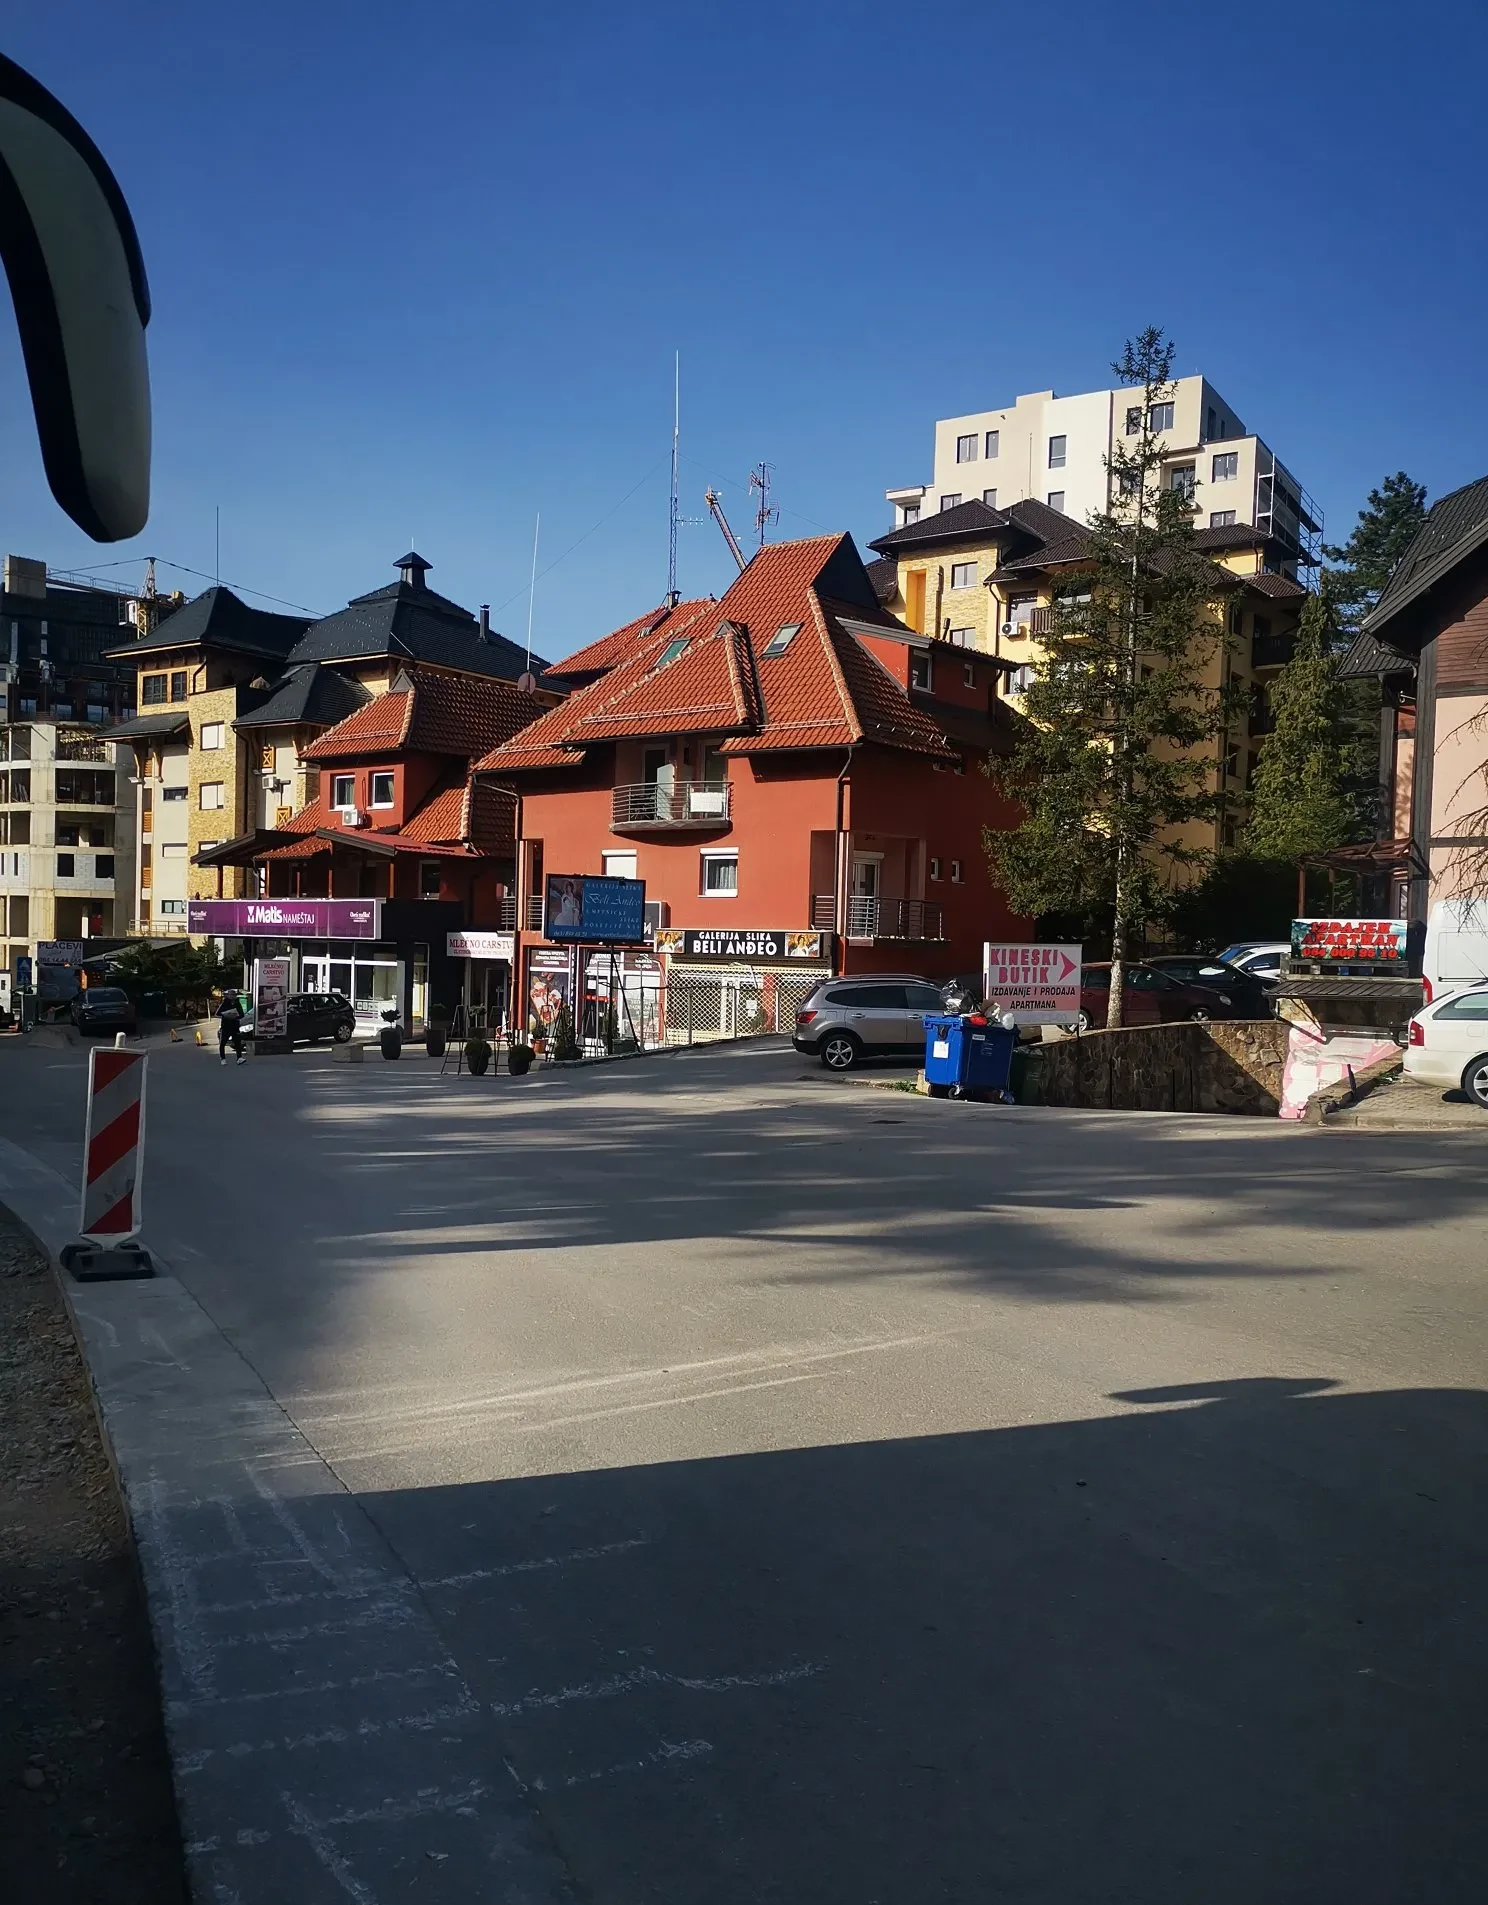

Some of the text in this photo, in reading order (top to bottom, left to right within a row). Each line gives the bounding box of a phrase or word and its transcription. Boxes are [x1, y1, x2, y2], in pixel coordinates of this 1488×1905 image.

[256, 906, 315, 924] Matis NAMEŠTAJ
[1310, 921, 1393, 934] IZDAJEM
[699, 931, 772, 941] GALERIJA SLIKA
[1301, 933, 1400, 946] APARTMAN
[38, 942, 82, 950] PLACEVI
[693, 939, 777, 956] BELI ANĐEO
[990, 948, 1058, 966] KINESKI
[999, 966, 1049, 984] BUTIK
[1033, 987, 1037, 996] I
[1039, 987, 1076, 996] PRODAJA
[1010, 1000, 1056, 1009] APARTMANA
